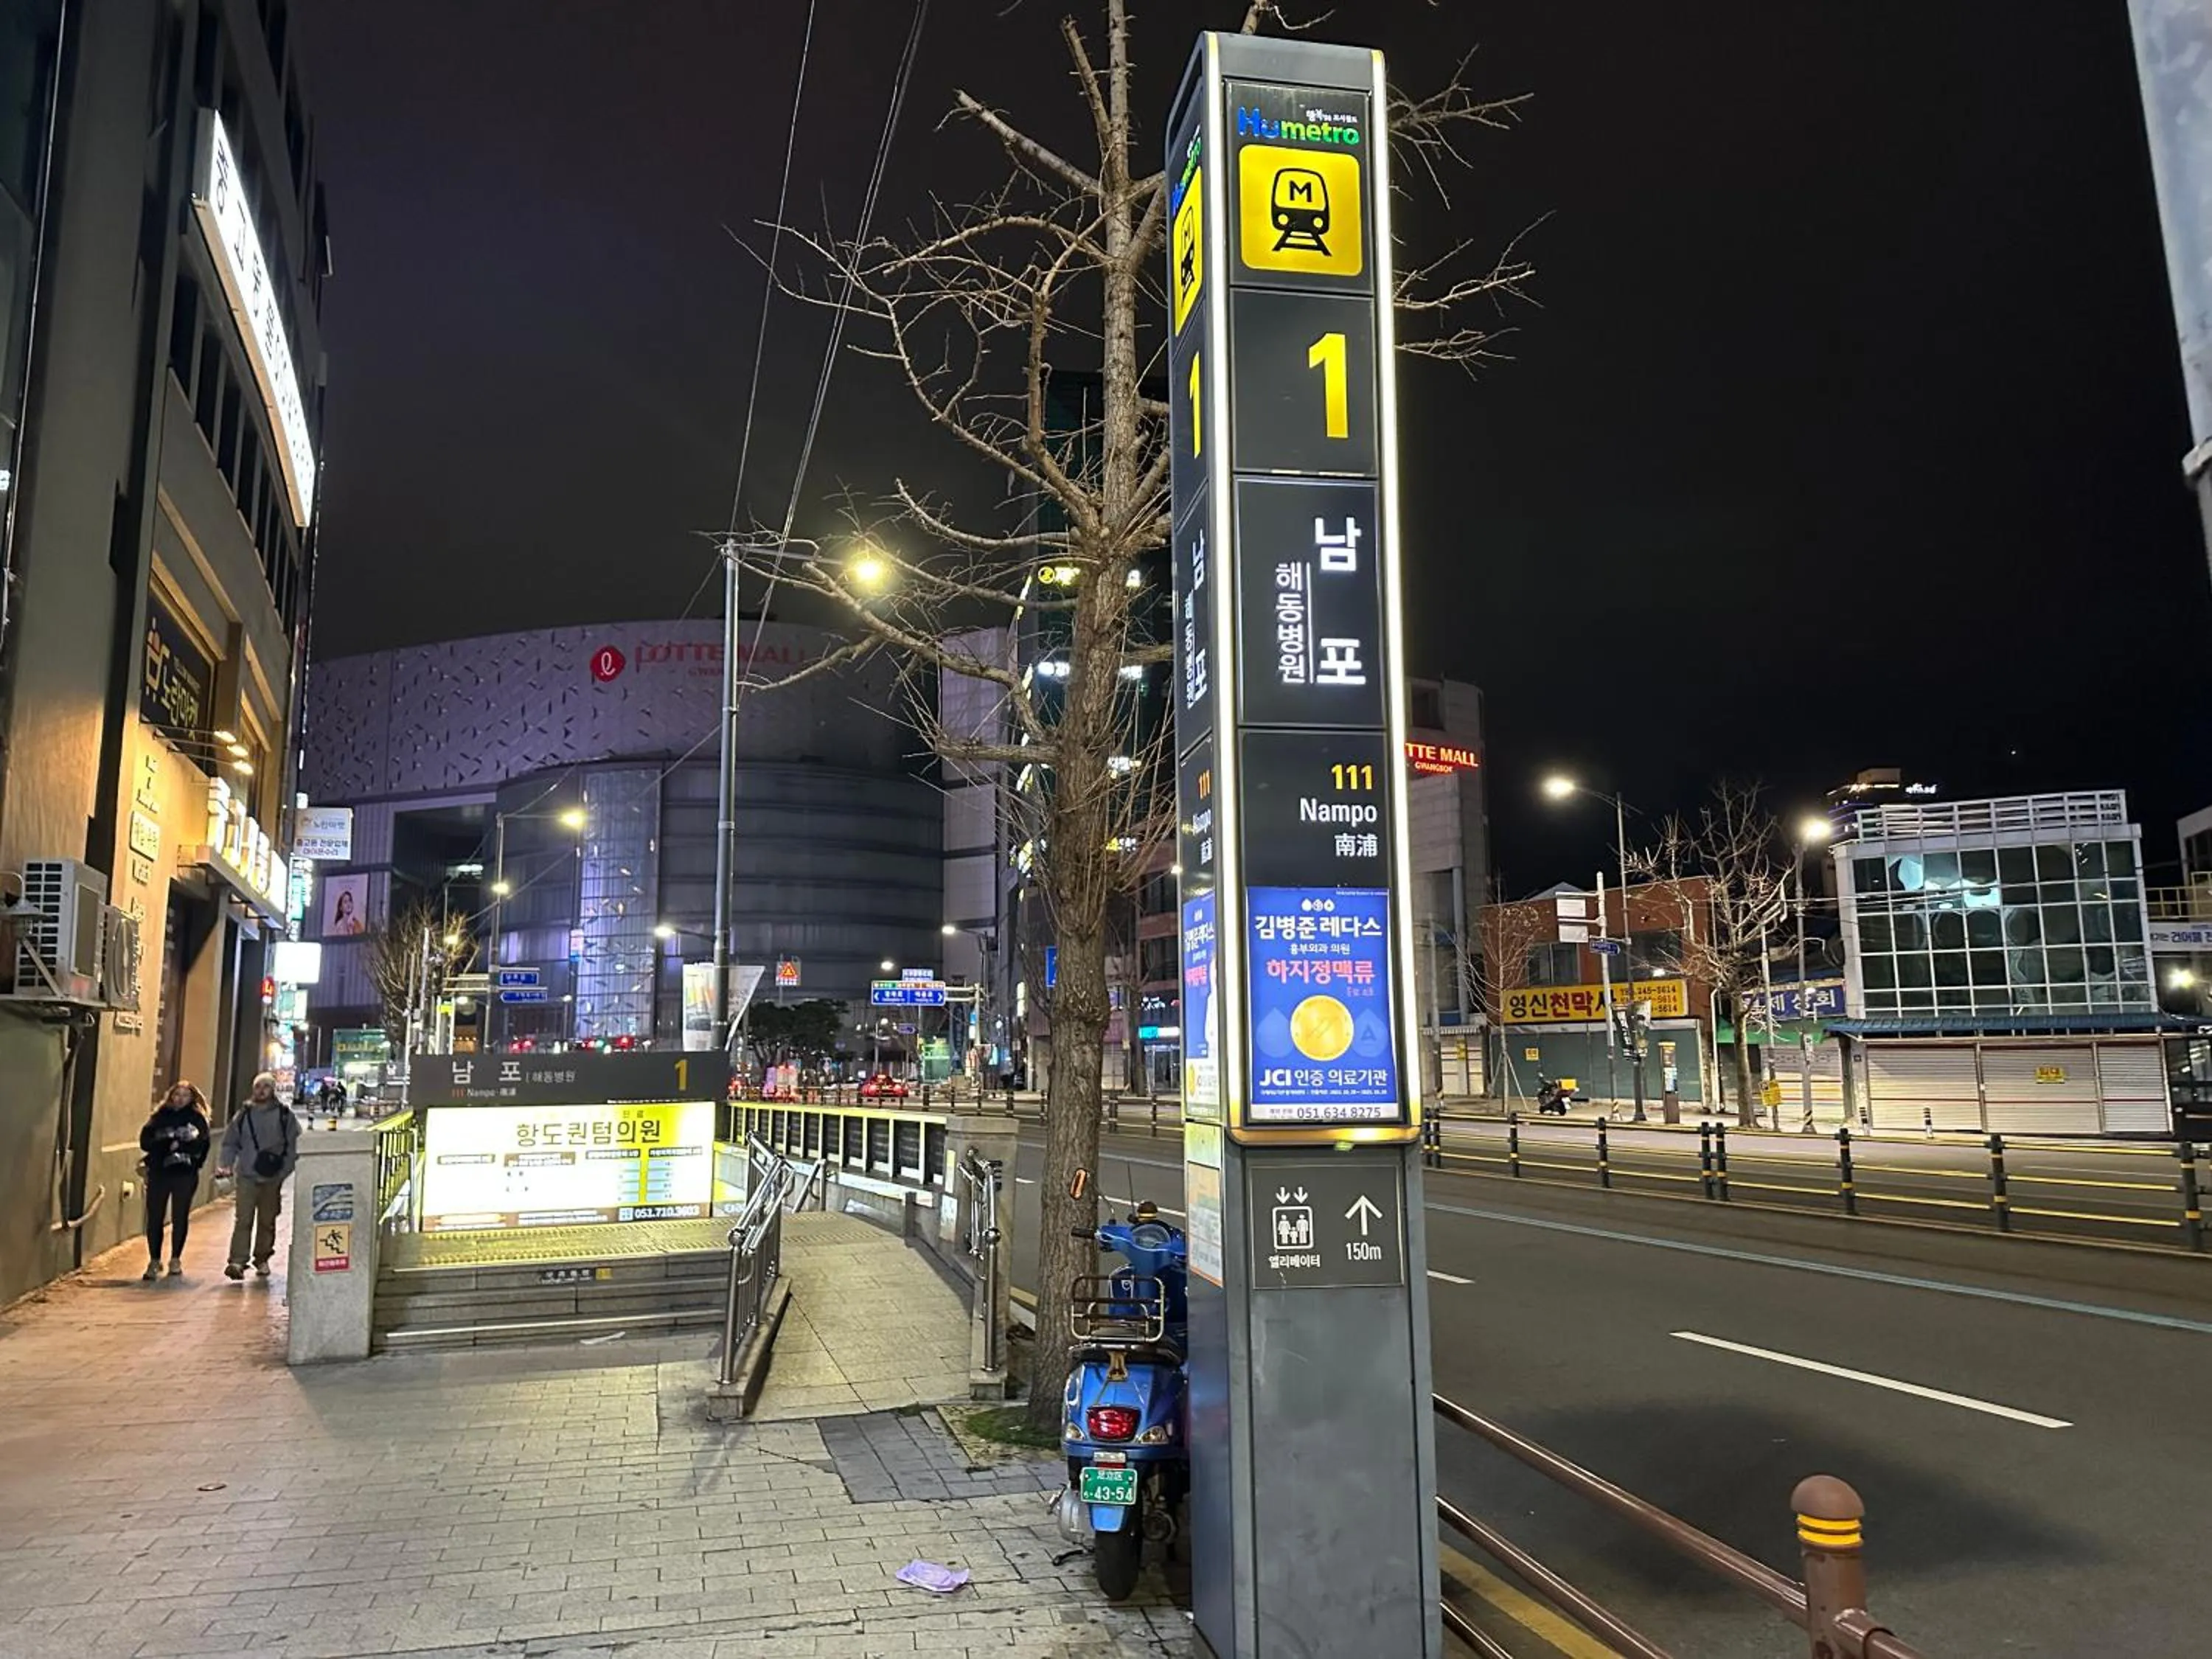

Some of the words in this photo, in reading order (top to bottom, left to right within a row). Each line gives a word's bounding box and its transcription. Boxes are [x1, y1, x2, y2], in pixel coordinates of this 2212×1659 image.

[1238, 105, 1360, 145] Humetro
[1289, 180, 1313, 204] M
[1309, 332, 1349, 439] 1
[1189, 351, 1201, 459] 1
[1275, 562, 1306, 684] 해동병원
[1405, 742, 1436, 760] TTE
[1440, 747, 1478, 767] MALL
[1331, 764, 1373, 790] 111
[1299, 798, 1378, 827] Nampo
[1334, 832, 1378, 858] 南浦
[1266, 959, 1376, 984] 하지정맥류
[532, 1071, 576, 1083] 해동병원
[674, 1059, 689, 1091] 1
[1259, 1068, 1293, 1087] JCI
[1294, 1069, 1325, 1087] 인증
[1327, 1068, 1388, 1086] 의료기관
[1296, 1106, 1381, 1119] 051.634.8275
[517, 1119, 661, 1147] 항도퀀텀의원
[1268, 1254, 1321, 1269] 엘리베이터
[1346, 1242, 1382, 1261] 150m
